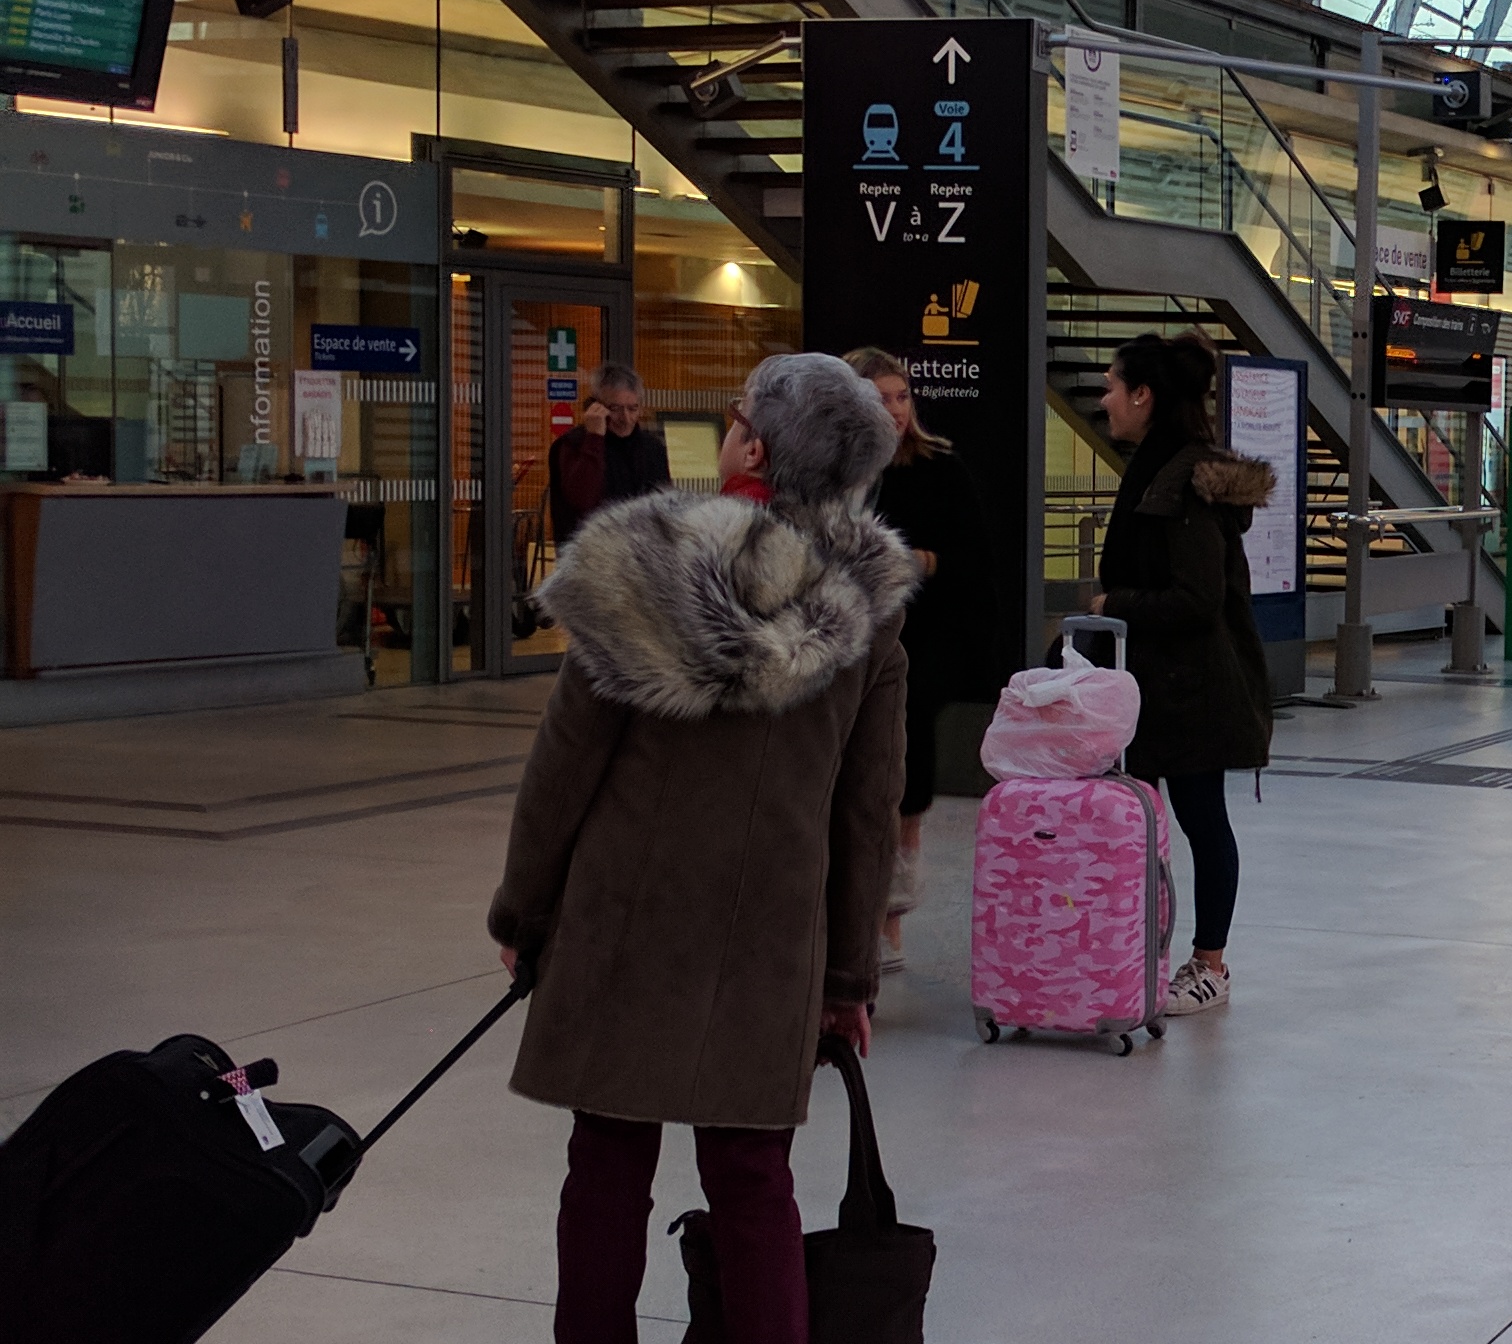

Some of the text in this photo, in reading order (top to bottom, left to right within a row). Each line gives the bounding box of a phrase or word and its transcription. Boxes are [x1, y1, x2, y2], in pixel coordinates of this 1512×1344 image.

[939, 103, 965, 115] Voie
[938, 122, 966, 162] 4
[859, 182, 901, 197] Repère
[930, 183, 973, 198] Repère
[865, 200, 966, 243] V à Z
[1391, 245, 1402, 265] de
[1404, 251, 1427, 269] vente
[313, 334, 396, 353] Espace de vente
[250, 280, 270, 444] nformation
[898, 358, 980, 379] letterie
[922, 386, 980, 399] Biglietteria
